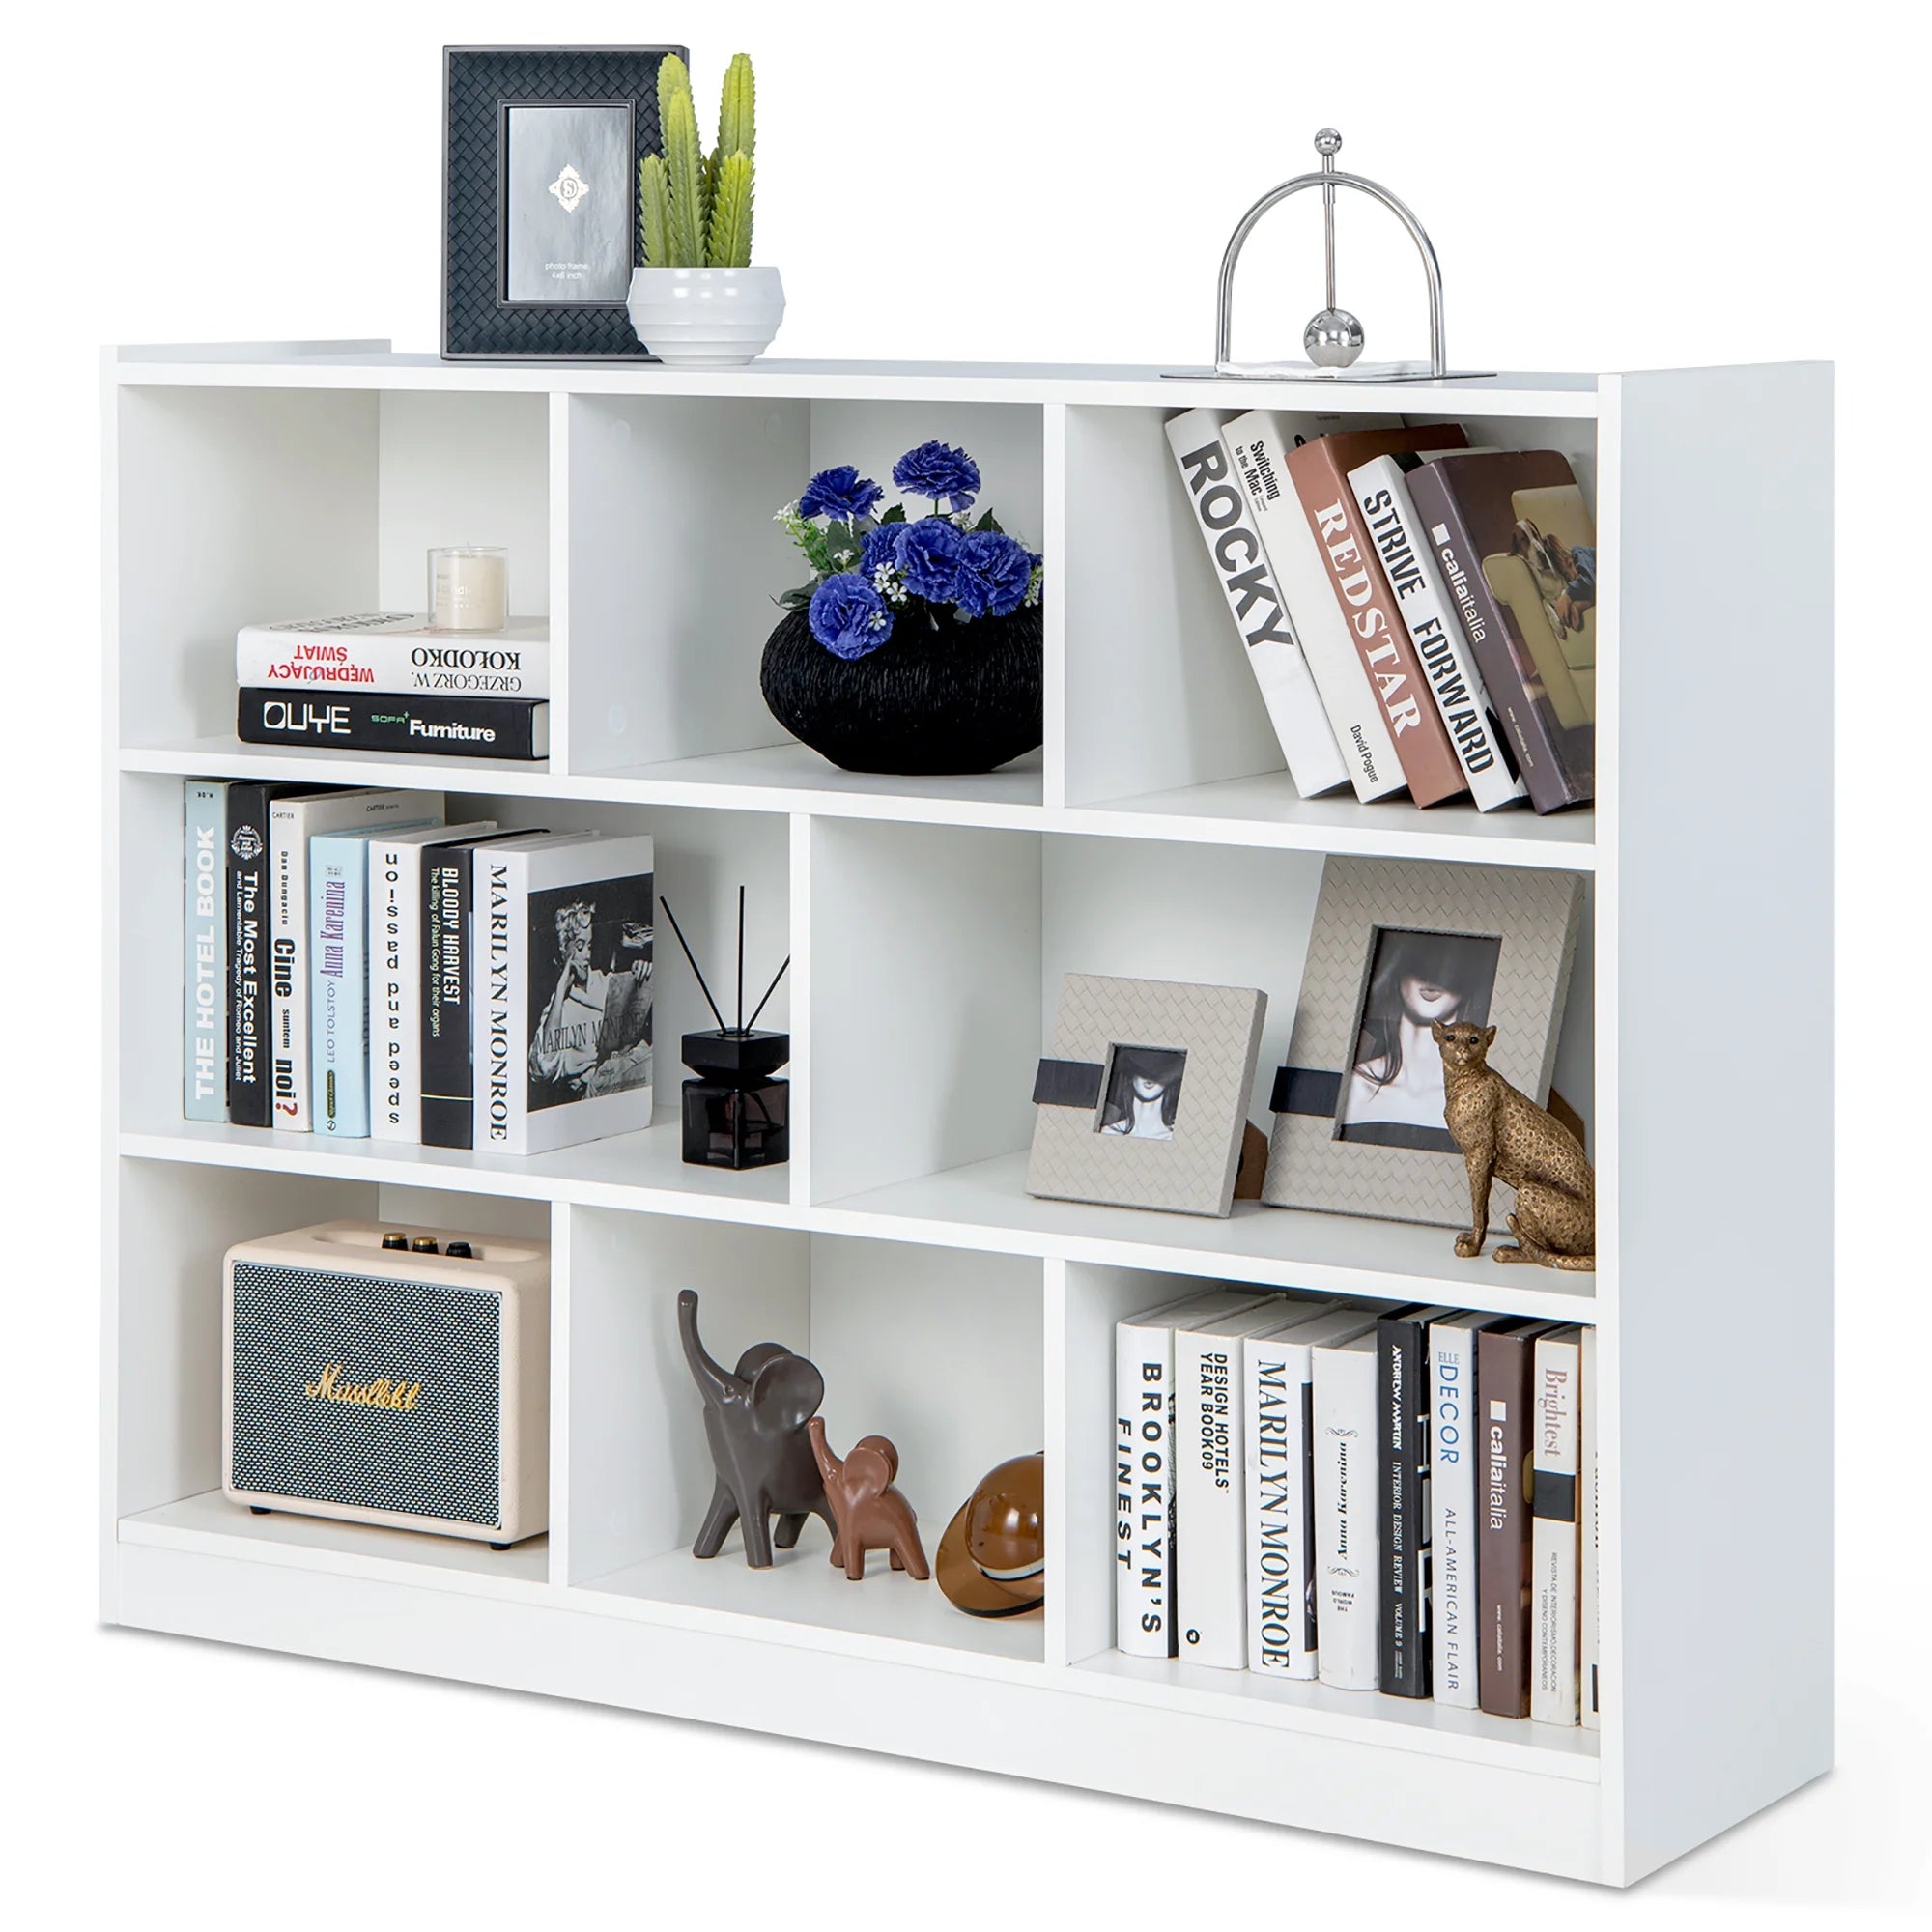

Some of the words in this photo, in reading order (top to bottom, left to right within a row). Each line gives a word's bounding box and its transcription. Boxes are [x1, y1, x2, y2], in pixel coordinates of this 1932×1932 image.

[1235, 445, 1244, 456] to
[1237, 455, 1250, 469] the
[1250, 440, 1281, 500] Switching
[1243, 468, 1263, 497] Mac
[1180, 440, 1294, 648] ROCKY
[1315, 498, 1423, 738] REDSTAR
[1440, 547, 1487, 645] caliaitalia
[294, 645, 348, 665] ŚWIAT
[1364, 489, 1427, 601] STRIVE
[1413, 616, 1493, 775] FORWARD
[268, 664, 375, 683] WĘDRUJĄCY
[411, 648, 522, 670] KOŁODKO
[412, 672, 432, 688] W.
[434, 673, 522, 692] GRZEGORZ
[410, 719, 496, 743] Furniture
[1350, 724, 1365, 752] David
[1360, 751, 1379, 783] Pogue
[196, 826, 215, 918] BOOK
[234, 871, 243, 890] and
[242, 871, 259, 913] The
[432, 867, 440, 884] The
[234, 891, 243, 946] Lamentable
[320, 881, 345, 941] Karenina
[385, 853, 399, 970] passion
[431, 885, 440, 911] killing
[433, 914, 440, 923] of
[442, 867, 459, 930] BLOODY
[242, 920, 258, 974] Most
[491, 864, 508, 1003] MARILYN
[196, 925, 215, 1029] HOTEL
[232, 948, 243, 986] Tragedy
[274, 938, 296, 998] Cine
[320, 945, 344, 979] Anna
[432, 949, 441, 971] Gong
[433, 973, 441, 986] for
[444, 934, 461, 1005] HARVEST
[234, 999, 243, 1034] Romeo
[235, 987, 243, 998] of
[326, 980, 336, 1036] TOLSTOY
[386, 980, 399, 1030] and
[234, 1036, 243, 1054] and
[242, 980, 258, 1084] Excellent
[281, 1009, 291, 1049] suntem
[432, 1009, 440, 1037] organs
[537, 1023, 586, 1054] MARILYN
[195, 1037, 215, 1100] THE
[234, 1055, 243, 1082] Juliet
[326, 1040, 336, 1064] LEO
[490, 1011, 508, 1141] MONROE
[274, 1059, 298, 1117] noi?
[387, 1041, 400, 1124] speed
[1200, 1352, 1214, 1396] YEAR
[1392, 1345, 1403, 1399] ANDREW
[1438, 1352, 1460, 1364] ELLE
[1213, 1353, 1228, 1416] DESIGN
[1258, 1359, 1288, 1515] MARILYN
[1392, 1401, 1402, 1451] MARTIN
[1439, 1364, 1460, 1463] DECOR
[1538, 1368, 1568, 1457] Brightest
[1117, 1417, 1132, 1571] FINEST
[1141, 1362, 1163, 1634] BROOKLYN'S
[1336, 1442, 1348, 1516] Karenina
[1392, 1461, 1402, 1512] INTERIOR
[1490, 1425, 1507, 1530] caliaitalia
[1337, 1520, 1349, 1561] Anna
[1393, 1513, 1403, 1552] DESIGN
[1260, 1521, 1290, 1668] MONROE
[1393, 1555, 1403, 1594] REVIEW
[1445, 1507, 1458, 1634] ALL-AMERICAN
[1550, 1582, 1557, 1592] DE
[1447, 1642, 1459, 1690] FLAIR
